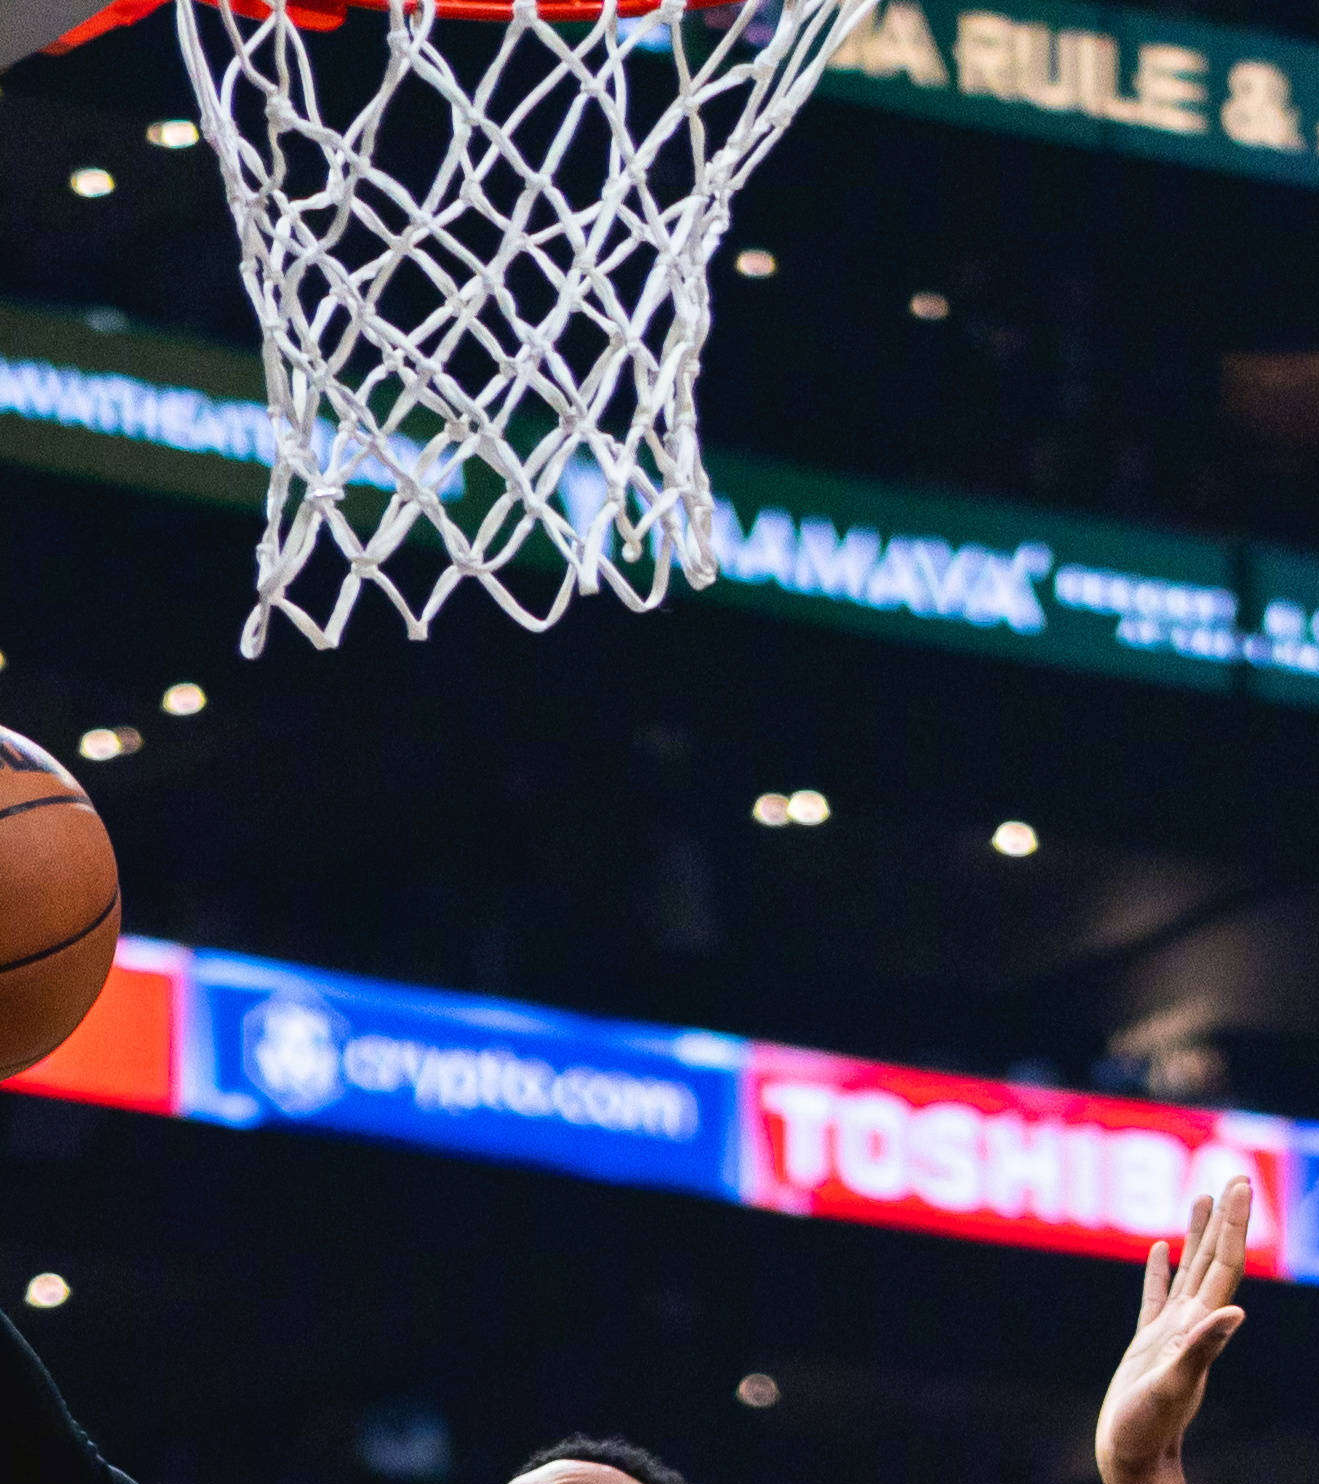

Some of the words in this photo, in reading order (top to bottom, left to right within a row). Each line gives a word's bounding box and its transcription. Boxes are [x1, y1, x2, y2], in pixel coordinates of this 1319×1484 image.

[954, 8, 1211, 136] RULE
[1218, 60, 1305, 152] &
[344, 1030, 700, 1142] crypto.com
[760, 1080, 1274, 1244] TOSHIBA
